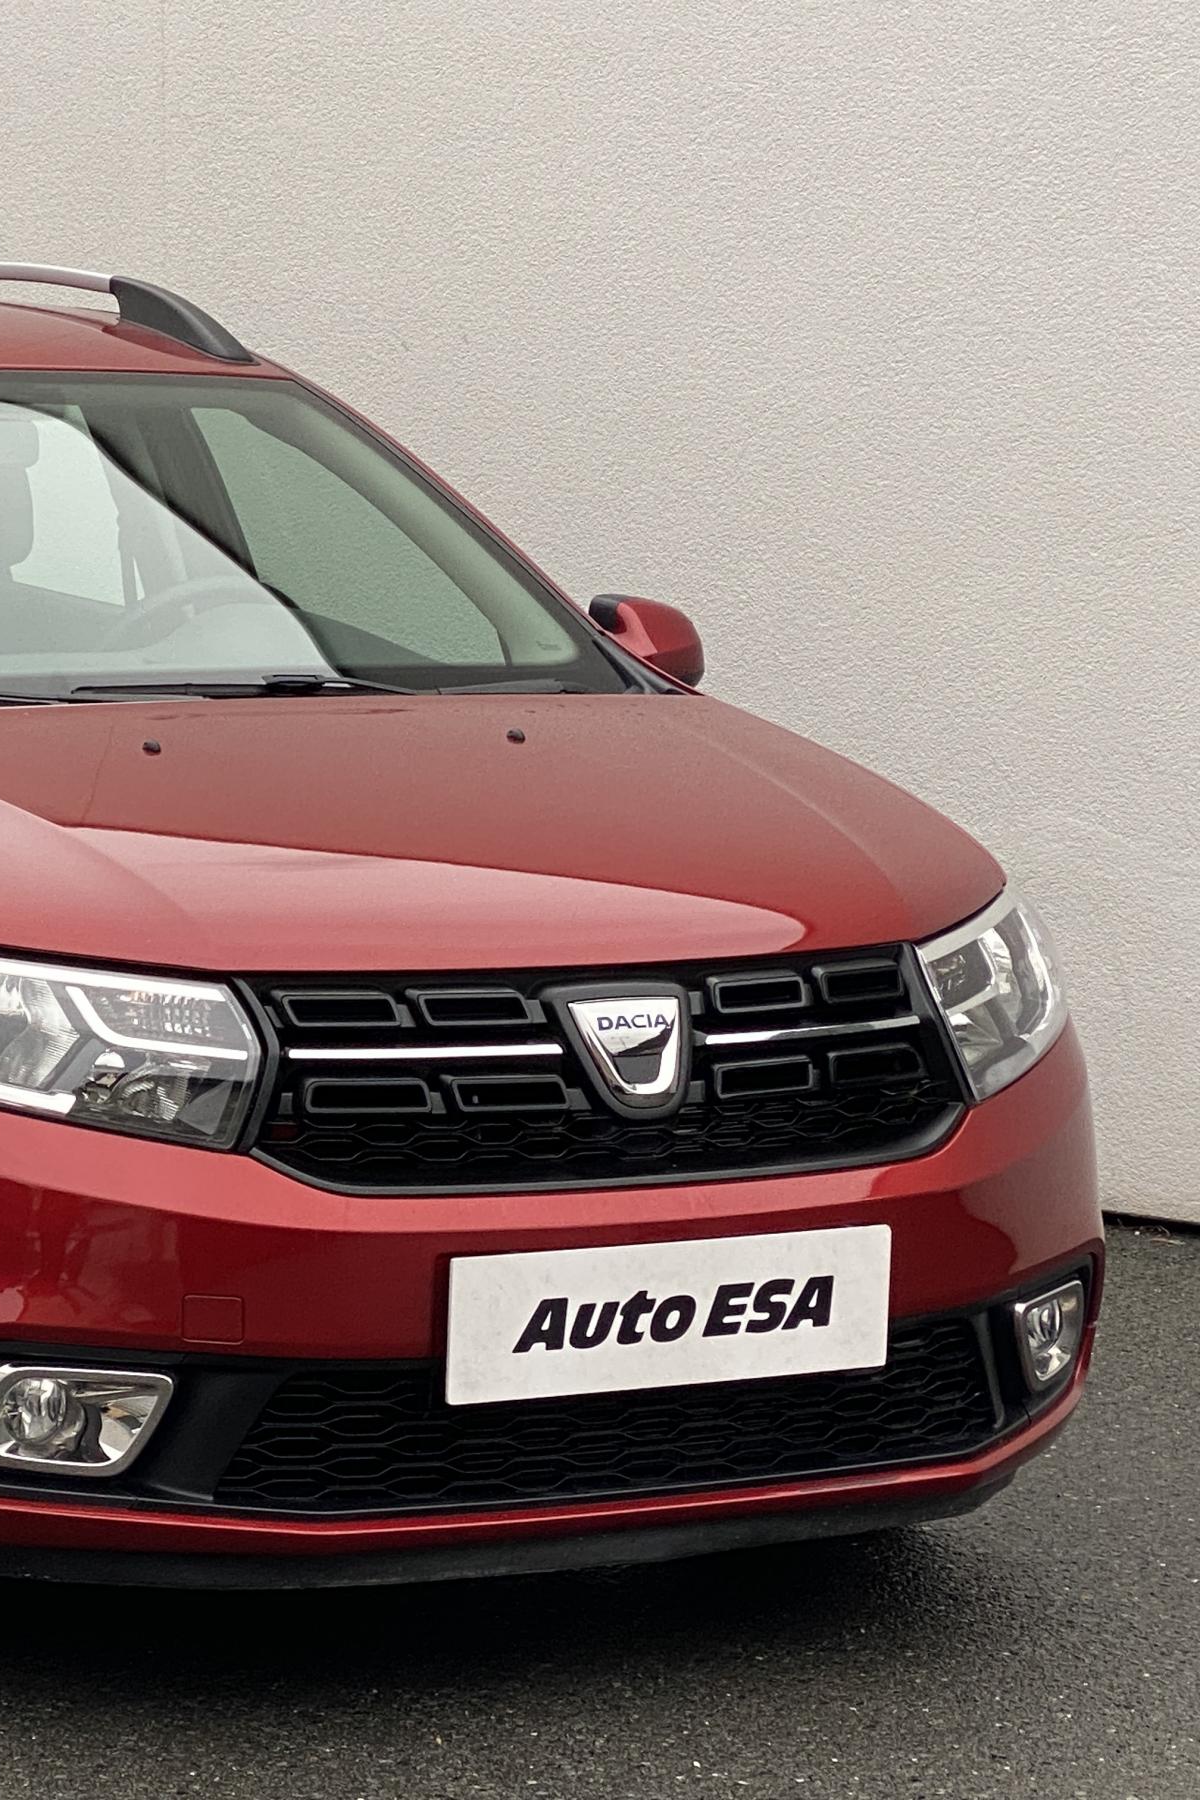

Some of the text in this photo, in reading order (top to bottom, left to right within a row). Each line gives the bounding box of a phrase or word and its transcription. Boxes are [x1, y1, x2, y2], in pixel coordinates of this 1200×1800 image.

[597, 1013, 672, 1031] DACIA
[512, 1276, 834, 1353] Auto ESA
